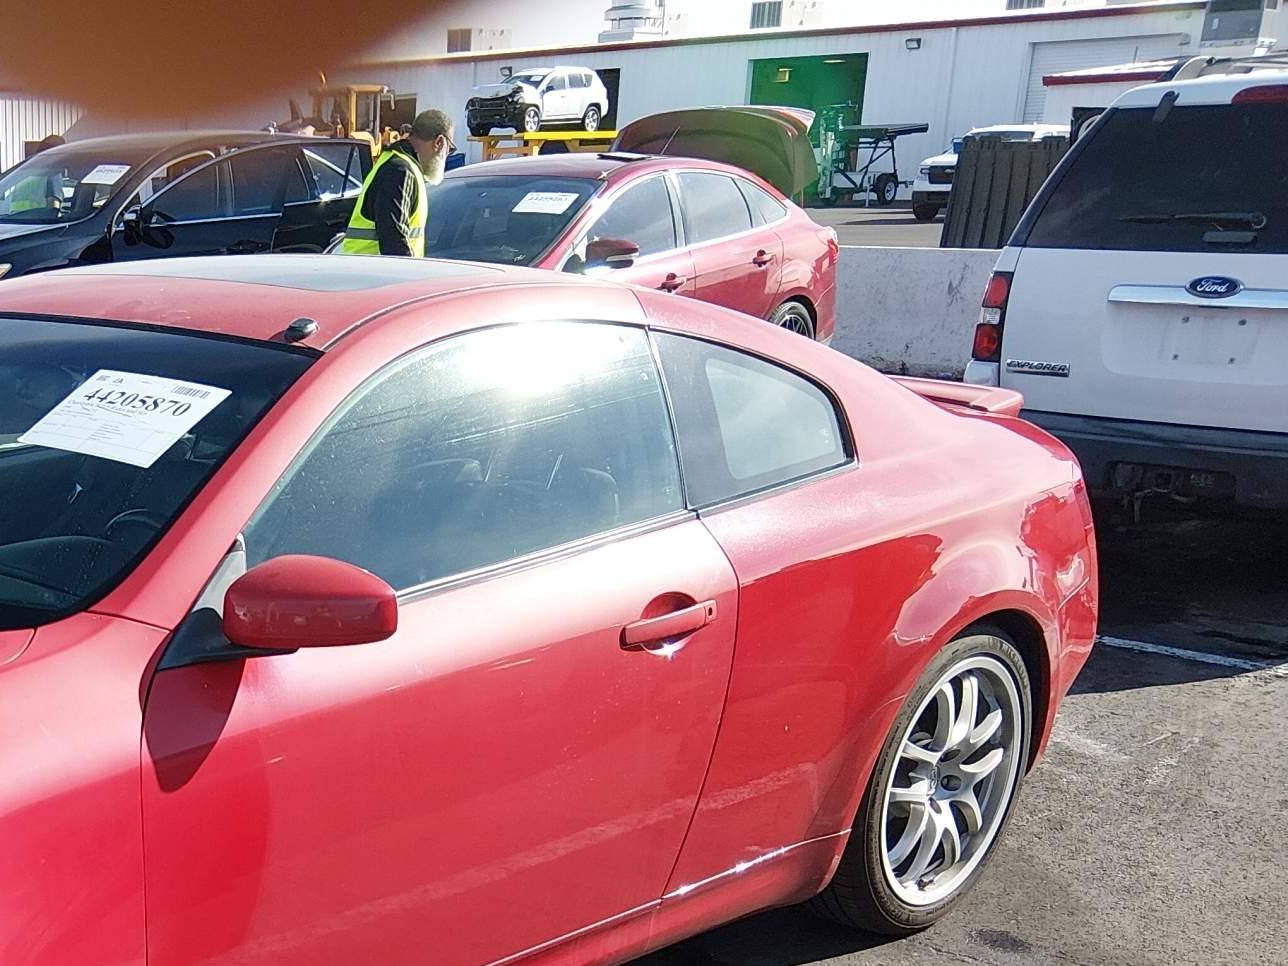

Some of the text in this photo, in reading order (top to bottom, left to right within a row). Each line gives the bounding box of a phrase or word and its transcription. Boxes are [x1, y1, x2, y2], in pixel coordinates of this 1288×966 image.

[1196, 279, 1228, 293] Ford
[1007, 360, 1068, 372] EXPLORER
[83, 388, 192, 417] 44205870
